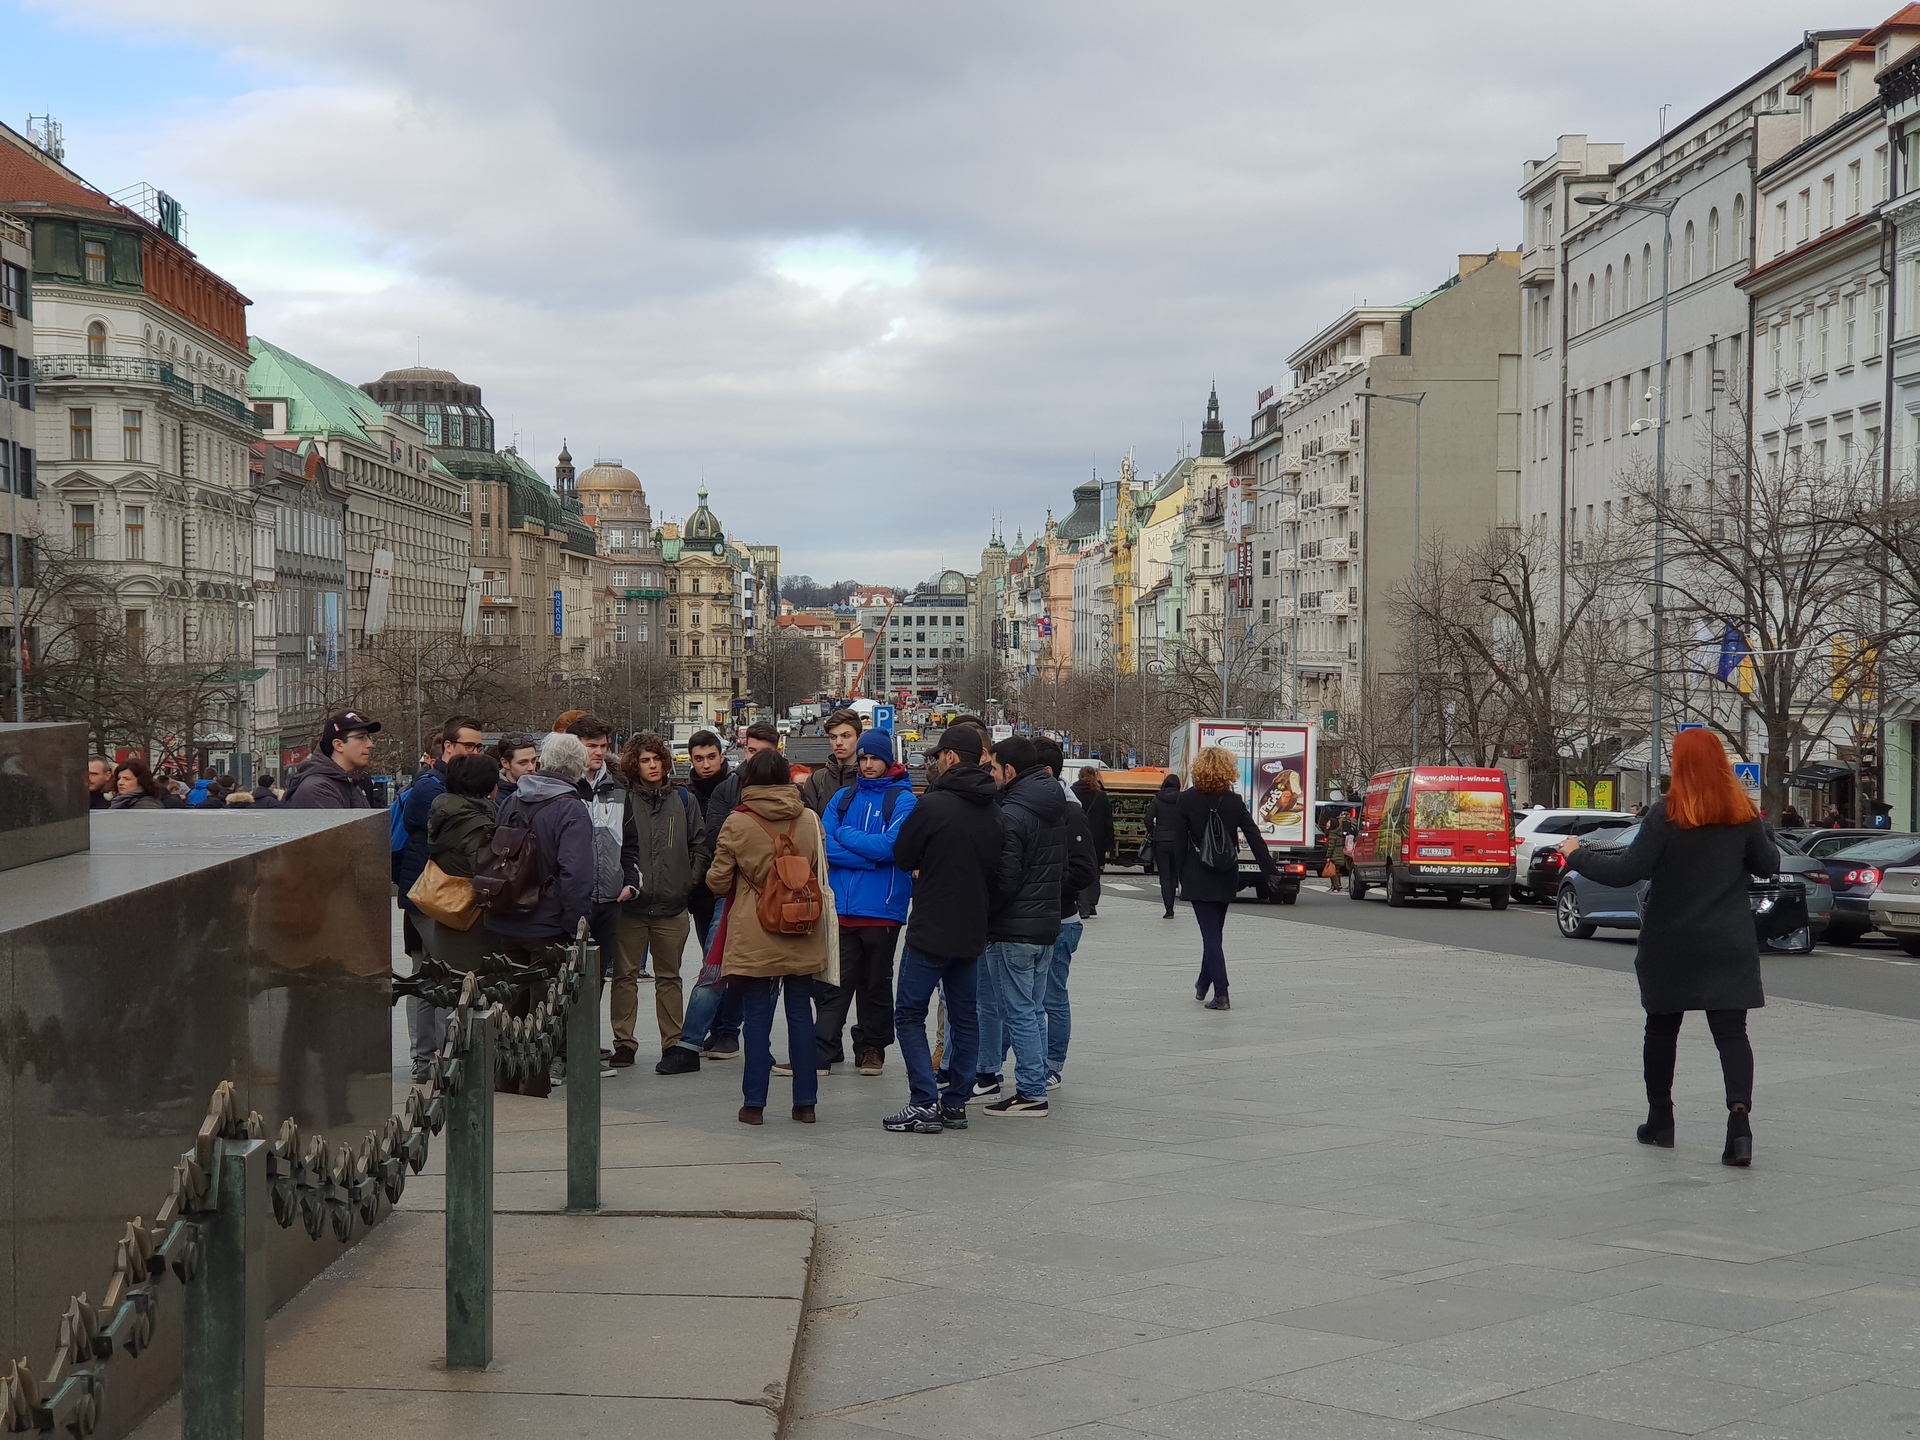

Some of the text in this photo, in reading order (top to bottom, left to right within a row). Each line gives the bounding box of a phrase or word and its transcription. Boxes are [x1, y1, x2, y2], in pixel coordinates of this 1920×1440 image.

[158, 190, 181, 241] SZIF
[1230, 493, 1239, 543] RAMADA
[877, 709, 890, 727] P
[1875, 815, 1883, 825] P
[1420, 865, 1448, 874] Volejte
[1466, 866, 1483, 874] 965
